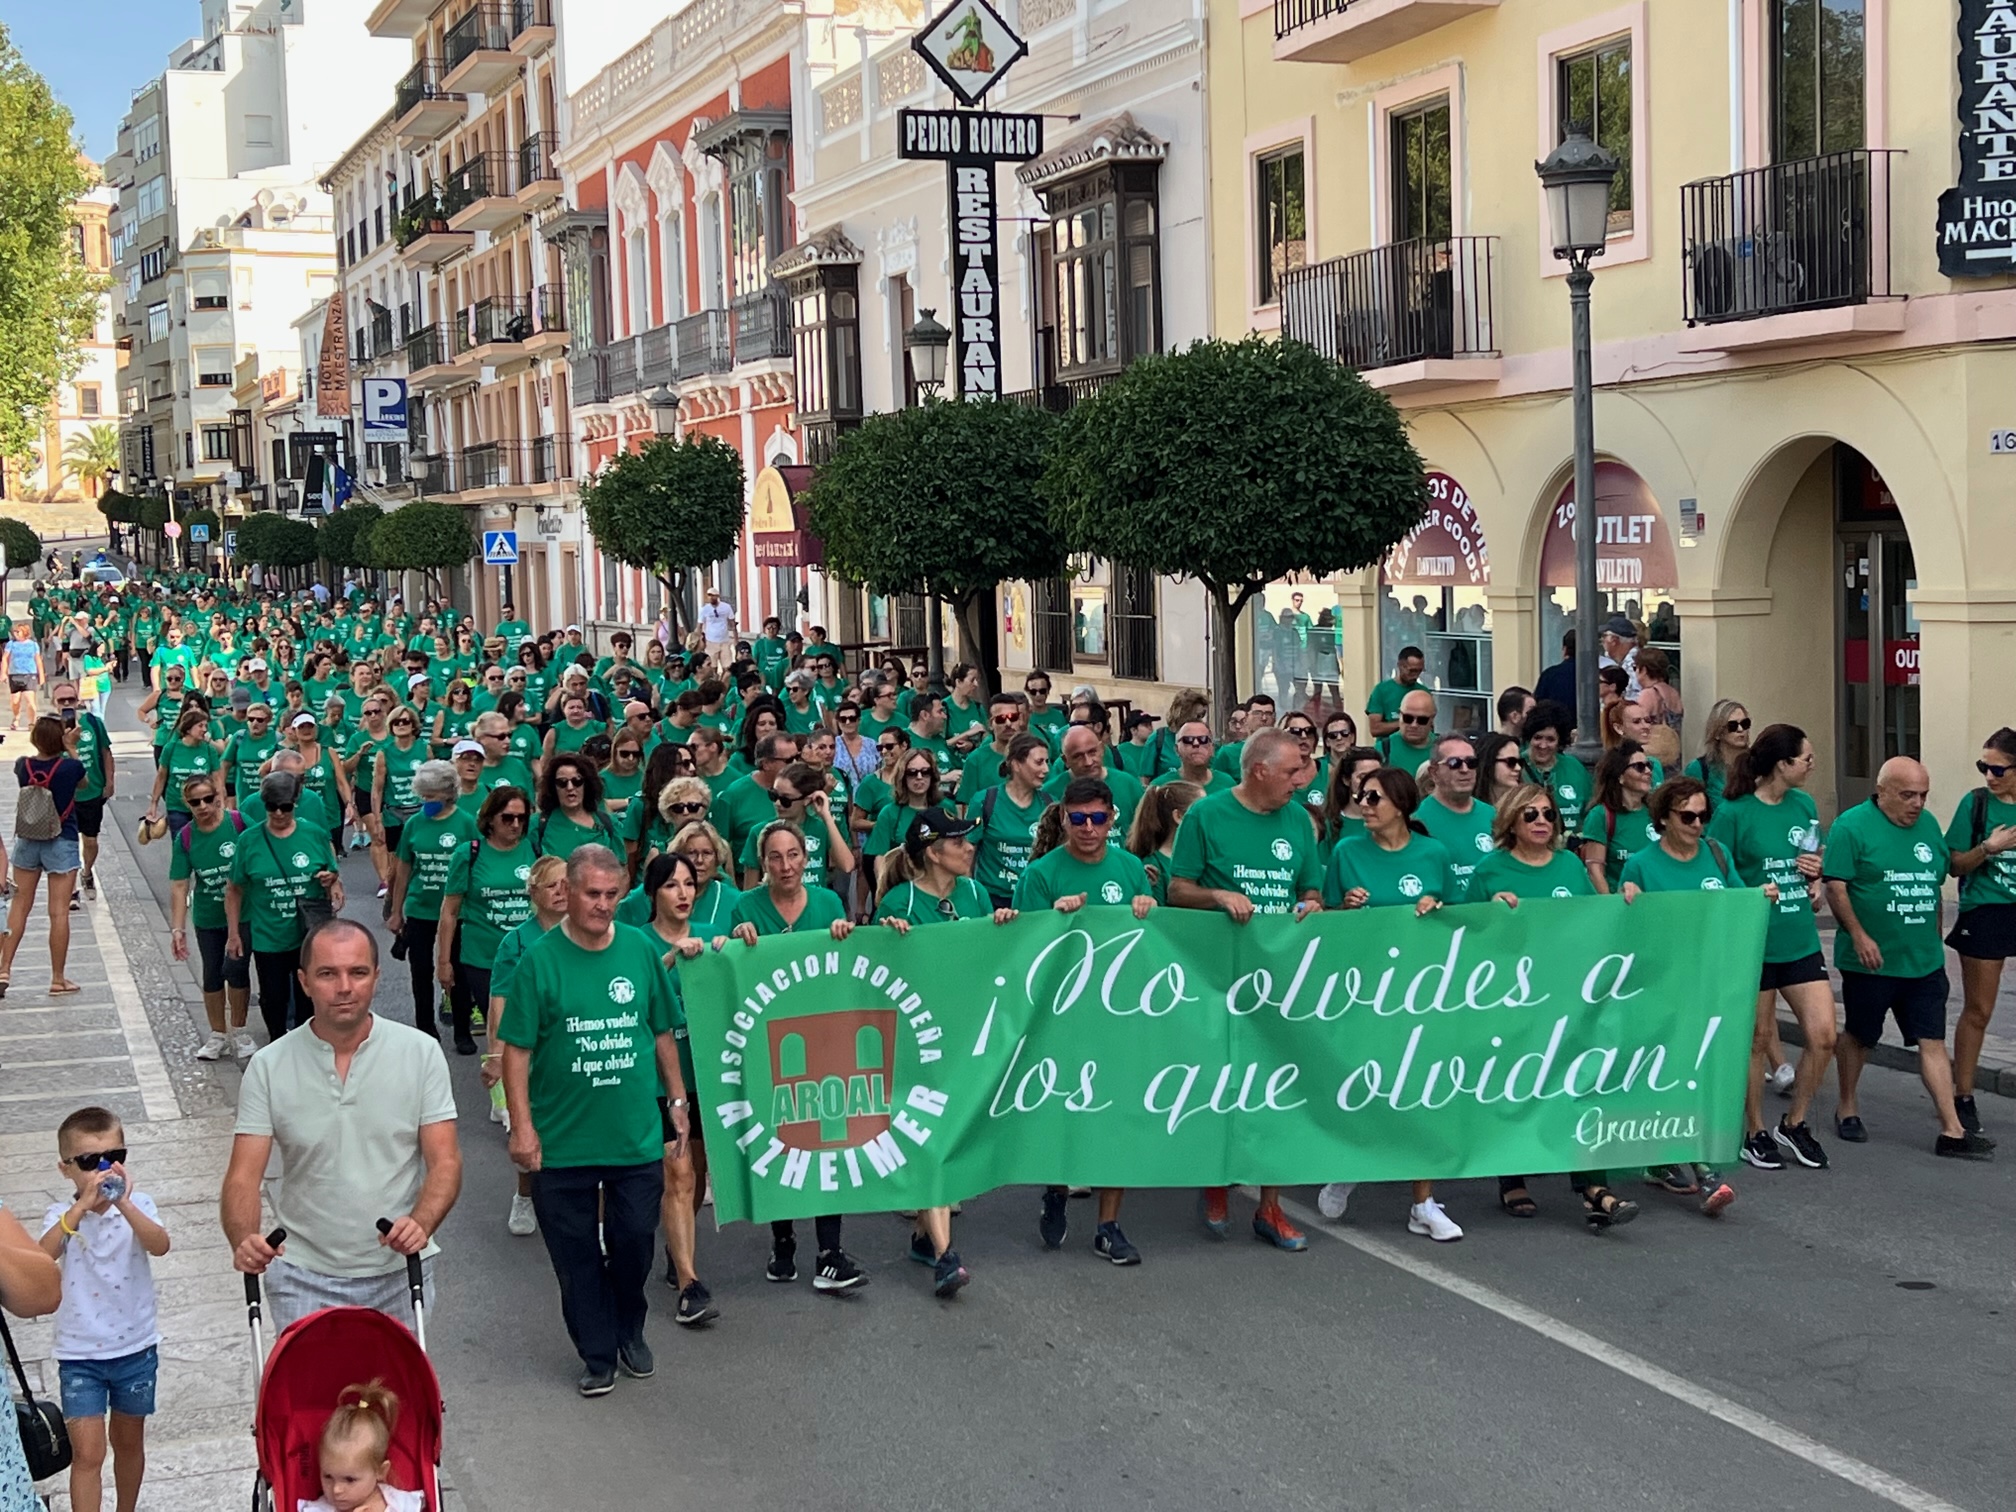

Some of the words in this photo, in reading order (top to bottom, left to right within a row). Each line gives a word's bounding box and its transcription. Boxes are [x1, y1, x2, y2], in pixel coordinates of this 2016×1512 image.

[905, 115, 961, 154] PEDRO
[968, 116, 1038, 156] ROMERO
[333, 297, 346, 391] MAESTRANZA
[321, 347, 332, 391] HOTEL
[1993, 432, 2016, 450] 16
[1451, 486, 1474, 522] DE
[1556, 502, 1576, 529] ZO
[1443, 514, 1480, 583] GOODS
[1571, 515, 1656, 544] UTLET
[1596, 557, 1643, 584] AVILETTO
[1260, 883, 1289, 898] olvides
[1886, 900, 1896, 912] al
[1896, 903, 1914, 916] que
[1224, 924, 1550, 1022] olvides
[1581, 951, 1645, 1006] a
[566, 1016, 605, 1033] ¡Hemos
[605, 1011, 638, 1029] vuelto!
[720, 950, 840, 1086] ASOCIACION
[851, 953, 944, 1064] RONDEÑA
[575, 1036, 598, 1052] “No
[599, 1032, 633, 1051] olvides
[571, 1056, 582, 1073] al
[583, 1060, 603, 1077] que
[604, 1052, 637, 1071] olvida”
[988, 1033, 1113, 1119] los
[1143, 1060, 1309, 1136] que
[1336, 1014, 1722, 1113] olvidan!
[771, 1073, 891, 1128] AROAL
[715, 1083, 949, 1192] ALZHEIMER
[1570, 1105, 1701, 1151] Gracias
